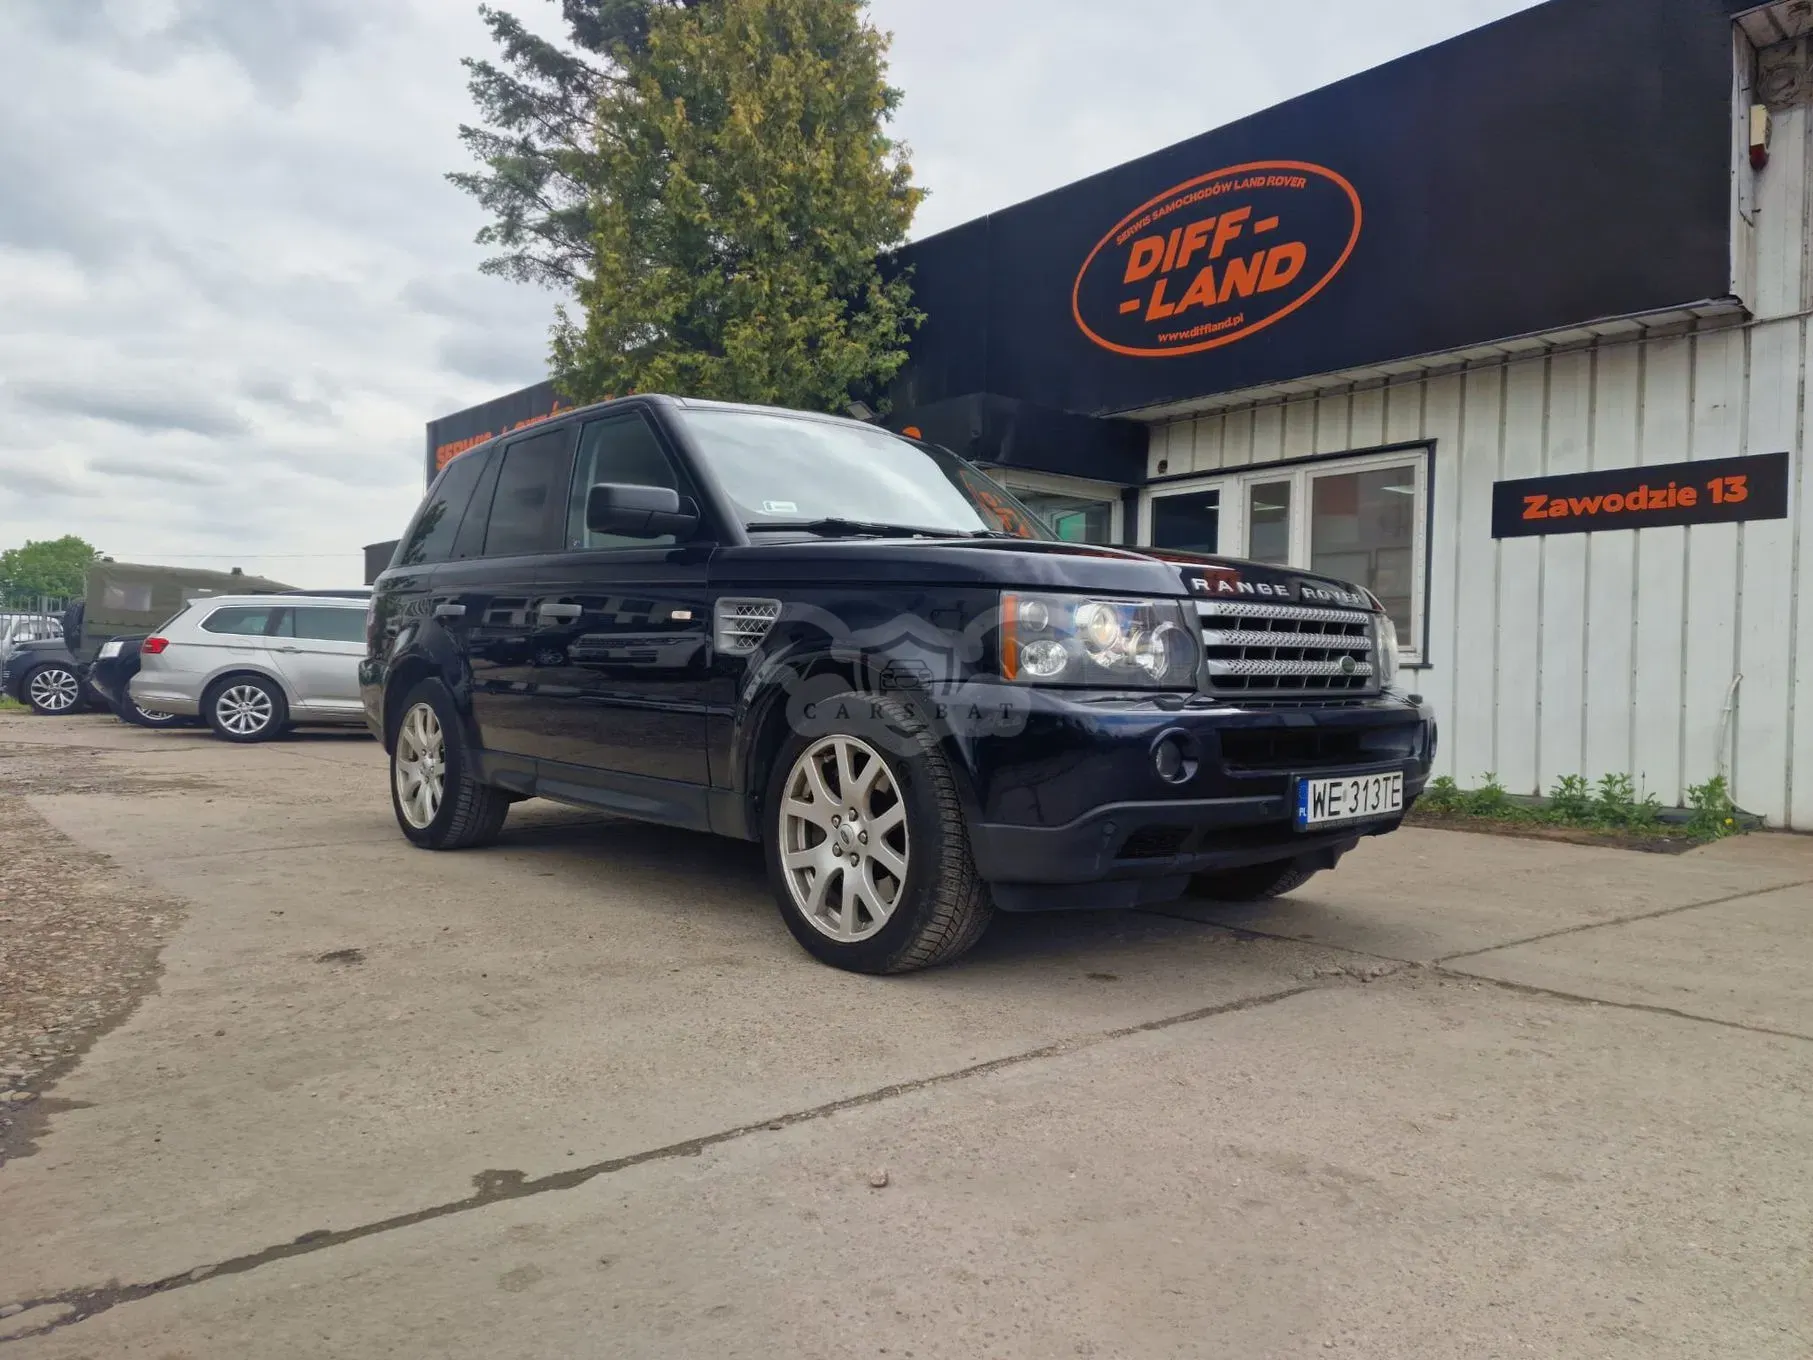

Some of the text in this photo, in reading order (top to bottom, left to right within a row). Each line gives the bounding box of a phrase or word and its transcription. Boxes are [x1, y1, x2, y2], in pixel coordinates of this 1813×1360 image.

[1116, 175, 1307, 246] SERWIS SAMOCHODÓW LAND ROVER
[1157, 311, 1245, 343] www.diffland.pl
[1521, 475, 1749, 520] Zawodzie 13
[1190, 577, 1291, 597] RANGE
[1312, 774, 1402, 819] WE 313TE
